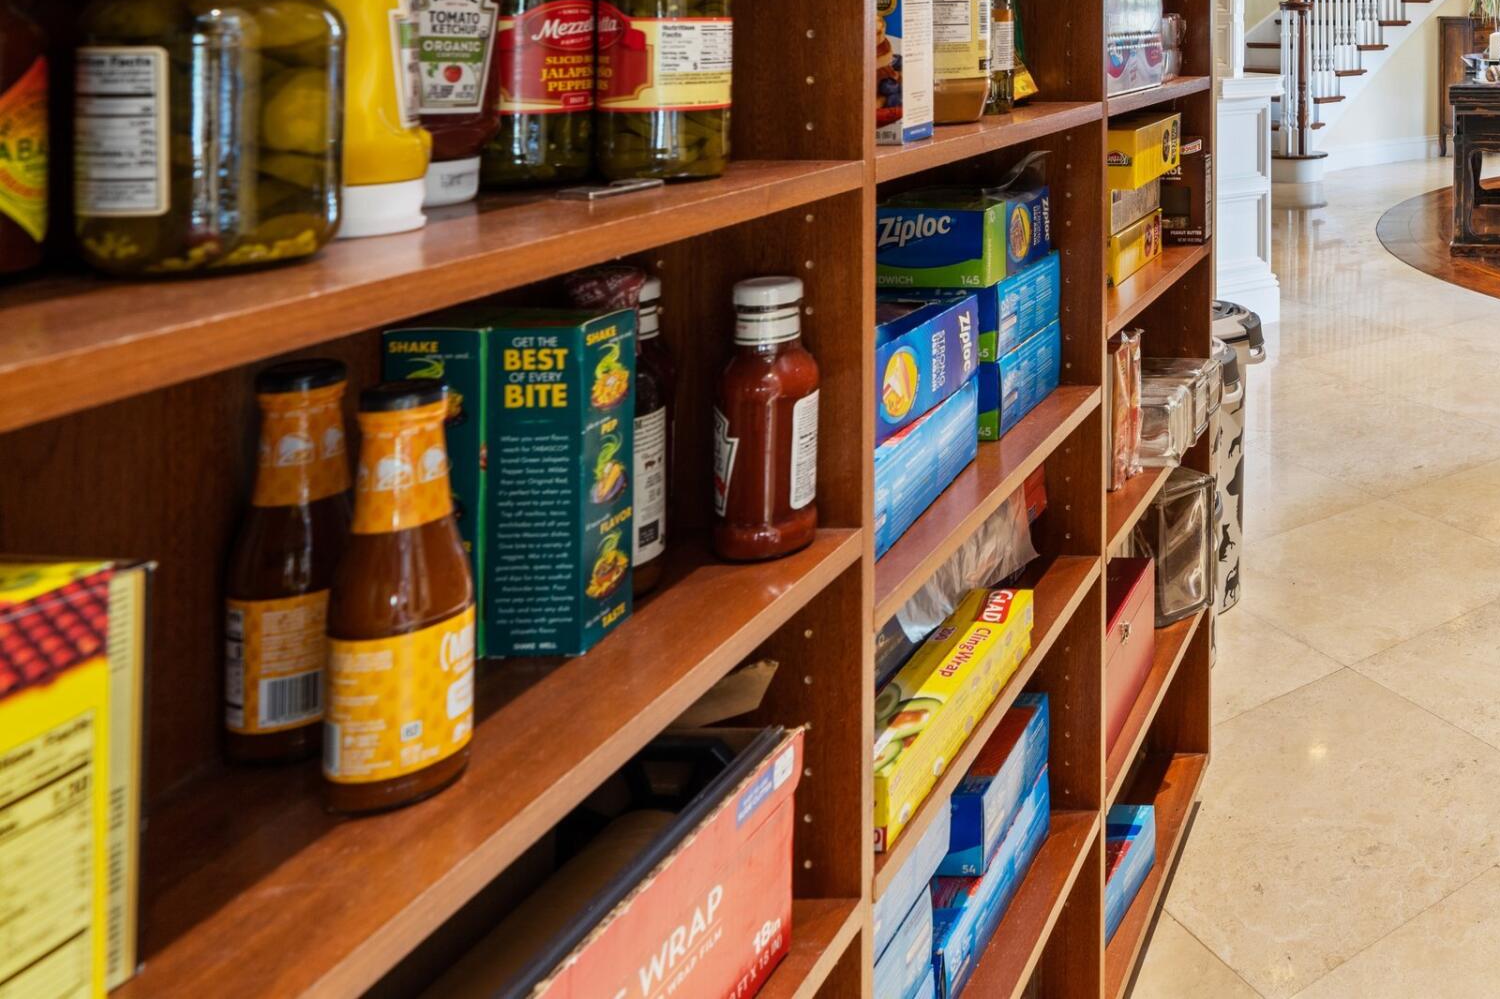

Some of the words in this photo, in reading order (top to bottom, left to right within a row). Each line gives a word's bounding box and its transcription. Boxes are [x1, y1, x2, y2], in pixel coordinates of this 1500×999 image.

[428, 9, 481, 25] TOMATO
[430, 23, 479, 35] KETCHUP
[422, 39, 482, 53] ORGANIC
[1042, 197, 1051, 242] Ziploc
[877, 214, 951, 248] Ziploc
[878, 275, 913, 285] DWICH
[961, 275, 980, 285] 145
[512, 336, 538, 348] GET
[539, 336, 559, 347] THE
[586, 325, 618, 346] SHAKE
[958, 310, 973, 373] Ziploc
[388, 341, 439, 354] SHAKE
[978, 347, 990, 358] 45
[503, 349, 569, 372] BEST
[509, 372, 526, 384] OF
[528, 371, 562, 383] EVERY
[503, 384, 568, 409] BITE
[978, 426, 992, 437] 45
[982, 589, 1014, 623] GLAD
[961, 864, 976, 875] 54
[639, 885, 723, 997] WRAP
